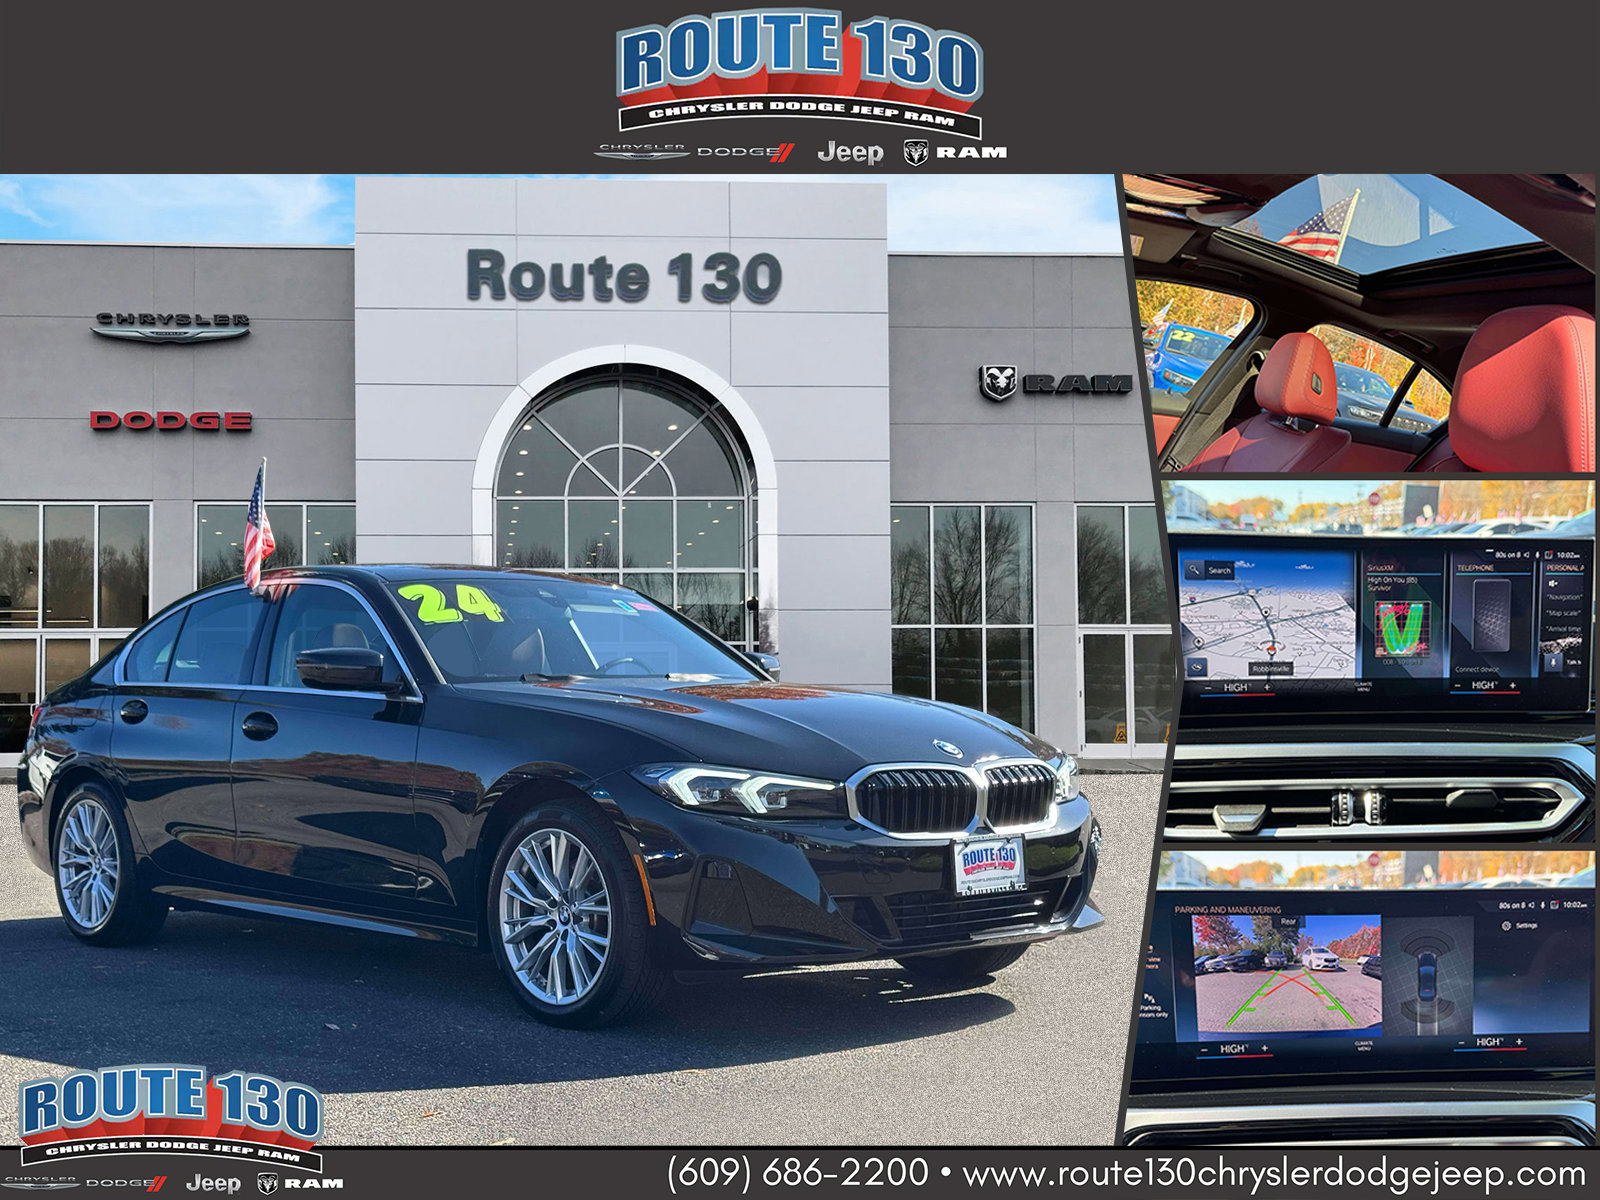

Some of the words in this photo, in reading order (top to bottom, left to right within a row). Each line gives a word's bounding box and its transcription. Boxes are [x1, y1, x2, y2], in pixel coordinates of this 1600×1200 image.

[466, 248, 651, 303] Route
[667, 252, 783, 305] 130
[96, 312, 249, 325] CHRYSLER
[1171, 330, 1196, 342] 22
[1022, 374, 1134, 394] RAM
[89, 410, 253, 431] DODGE
[1208, 566, 1231, 575] Search
[1367, 576, 1382, 585] High
[1382, 576, 1392, 584] On
[1392, 576, 1406, 584] You
[1367, 584, 1392, 592] Survivor
[397, 584, 505, 624] 24
[1252, 664, 1291, 674] Robbinsville
[1455, 665, 1480, 673] Connect
[1223, 683, 1248, 692] HIGH
[1472, 681, 1495, 690] HIGH
[962, 848, 995, 867] ROUTE
[997, 847, 1016, 862] 130
[1174, 906, 1209, 914] PARKING
[1209, 906, 1227, 914] AND
[1227, 906, 1282, 914] MANEUVERING
[1516, 922, 1538, 930] Settings
[1476, 1037, 1500, 1046] HIGH
[1220, 1044, 1246, 1054] HIGH
